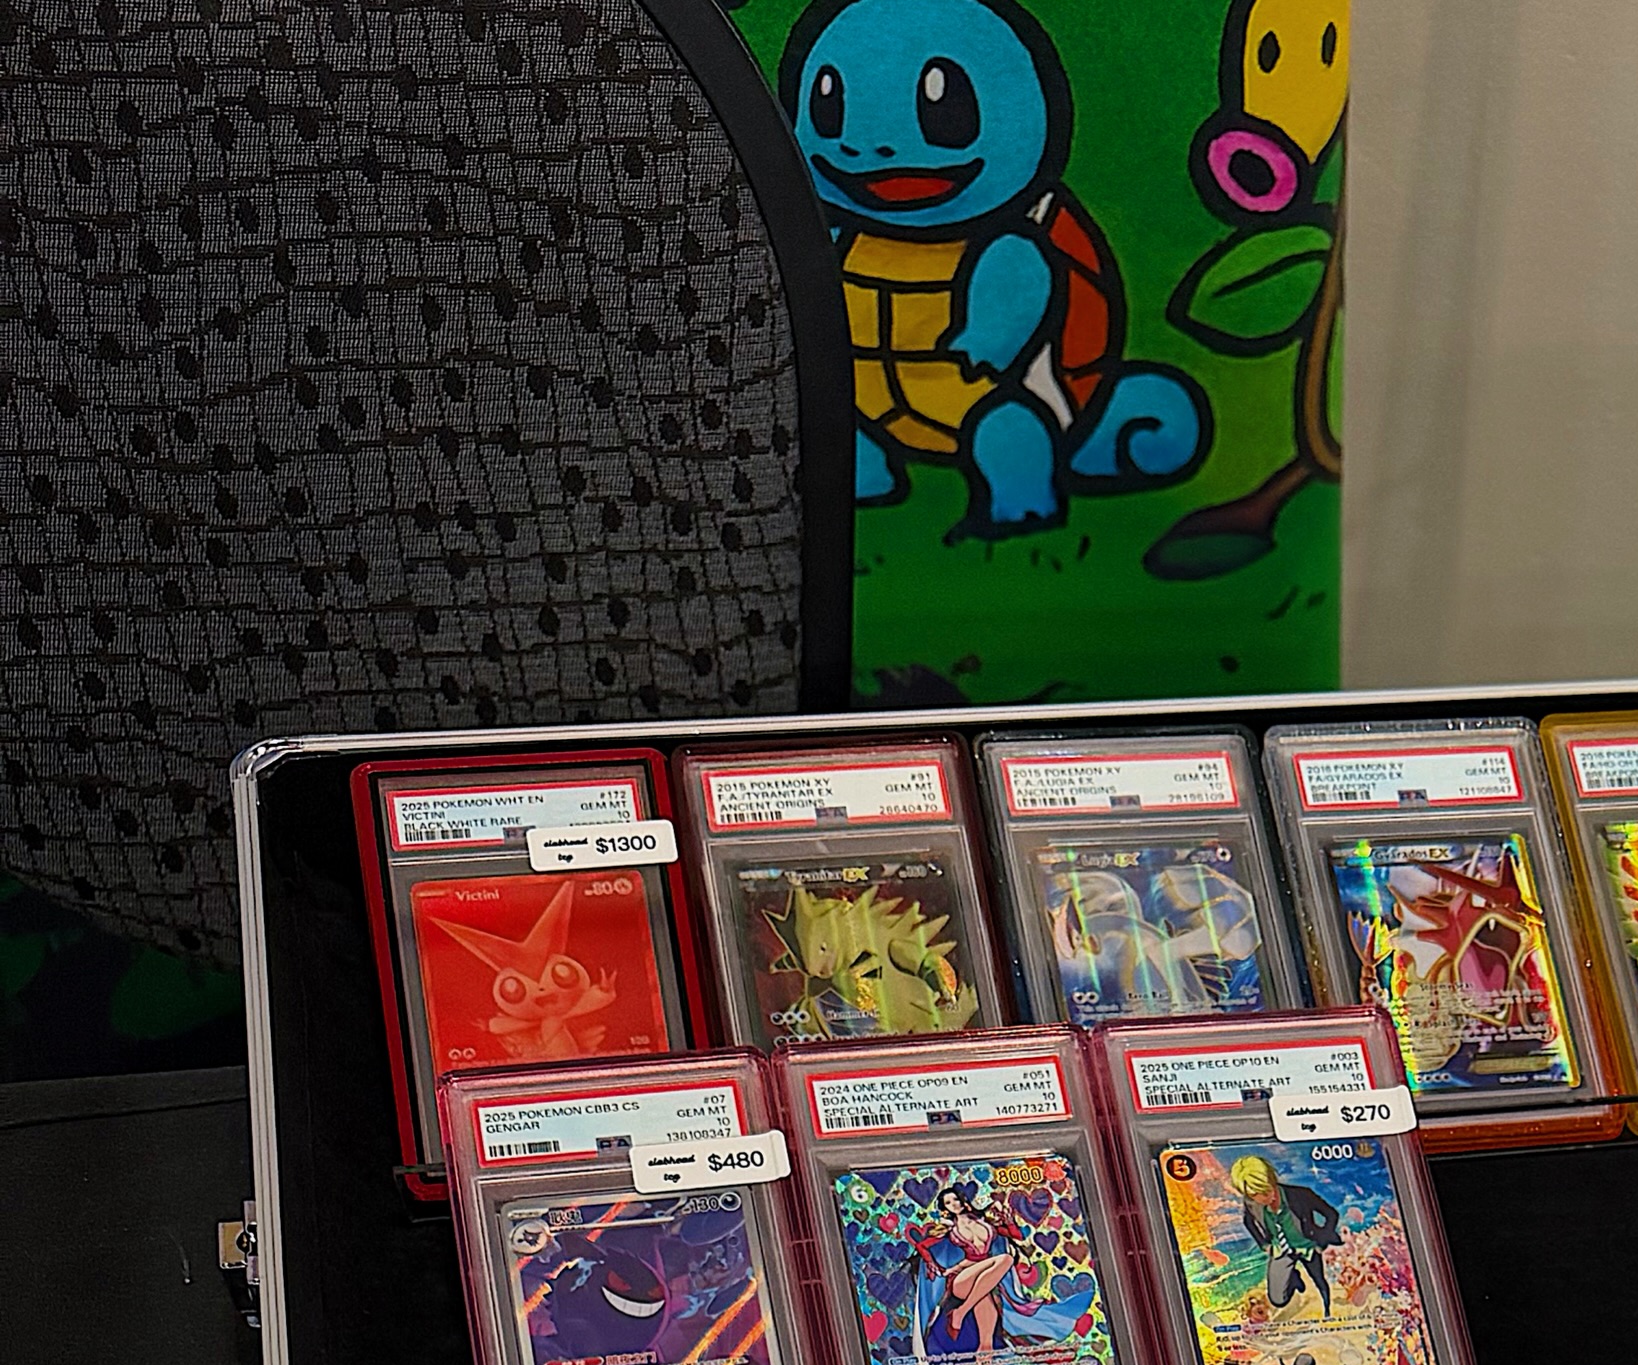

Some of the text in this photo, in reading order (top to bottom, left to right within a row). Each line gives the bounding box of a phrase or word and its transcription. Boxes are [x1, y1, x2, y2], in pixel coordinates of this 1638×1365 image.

[751, 780, 810, 790] POKEMON
[403, 810, 445, 820] VICTINI
[596, 836, 656, 854] $1300
[456, 890, 500, 900] Victini
[1140, 1063, 1168, 1072] 2025
[1172, 1060, 1196, 1071] ONE
[1199, 1059, 1230, 1068] PIECE
[1265, 1056, 1279, 1065] EN
[1315, 1062, 1360, 1073] GEM MT
[1022, 1070, 1050, 1080] #051
[1143, 1073, 1178, 1083] SANJI
[1352, 1073, 1364, 1081] 10
[820, 1076, 968, 1096] 2024 ONE PIECE OP09 EN
[1004, 1081, 1051, 1092] GEM MT
[1145, 1077, 1290, 1094] SPECIAL ALTERNATE ART
[823, 1092, 912, 1106] BOA HANCOCK
[1042, 1092, 1055, 1100] 10
[485, 1112, 516, 1123] 2025
[518, 1105, 582, 1120] POKEMON
[622, 1102, 639, 1111] CS
[677, 1106, 727, 1118] GEM MT
[824, 1098, 978, 1117] SPECIAL ALTERNATE ART
[996, 1103, 1058, 1115] 140773271
[1340, 1104, 1390, 1122] $270
[486, 1122, 540, 1133] GENGAR
[1312, 1144, 1352, 1160] 6000
[708, 1151, 764, 1172] $480
[998, 1168, 1042, 1184] 8000
